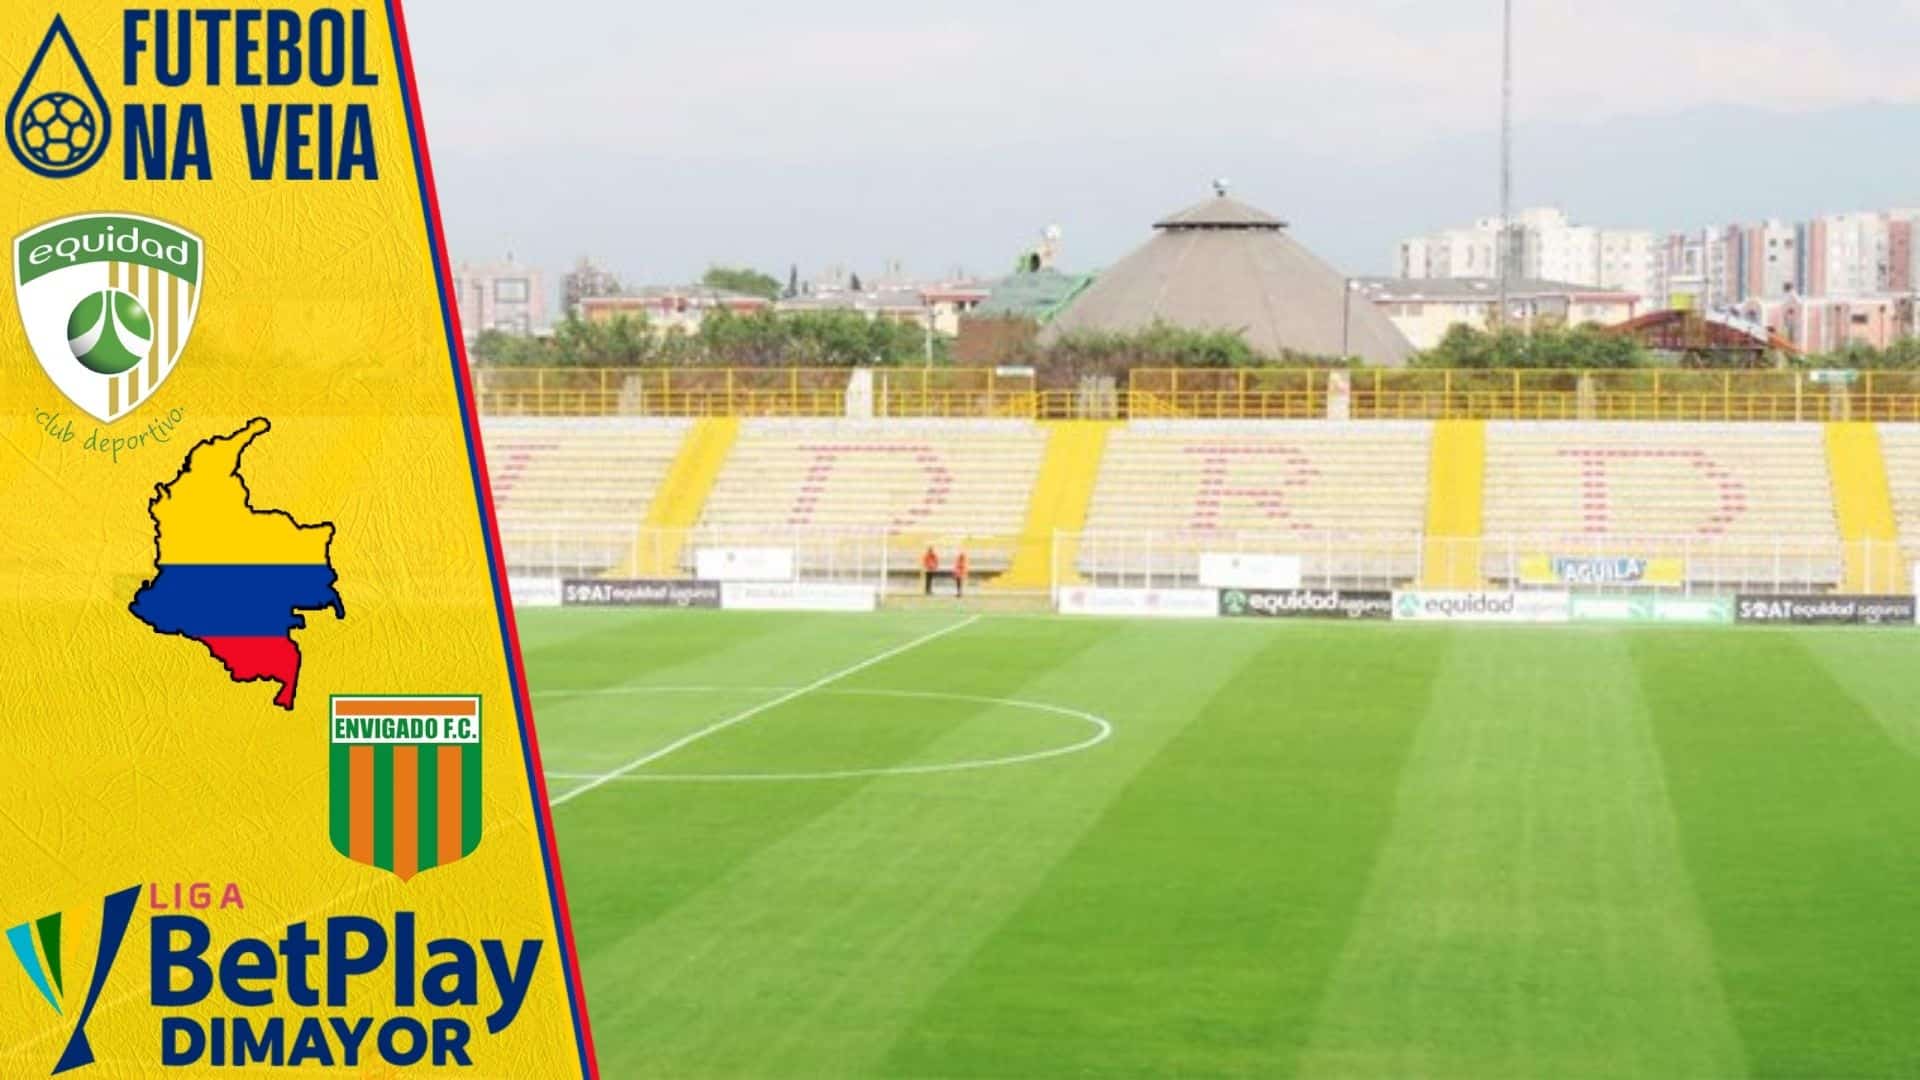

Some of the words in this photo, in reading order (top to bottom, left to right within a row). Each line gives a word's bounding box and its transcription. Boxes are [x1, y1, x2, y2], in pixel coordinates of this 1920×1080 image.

[1248, 590, 1339, 614] equidad
[1424, 592, 1515, 617] equidad
[1792, 601, 1855, 618] equidad
